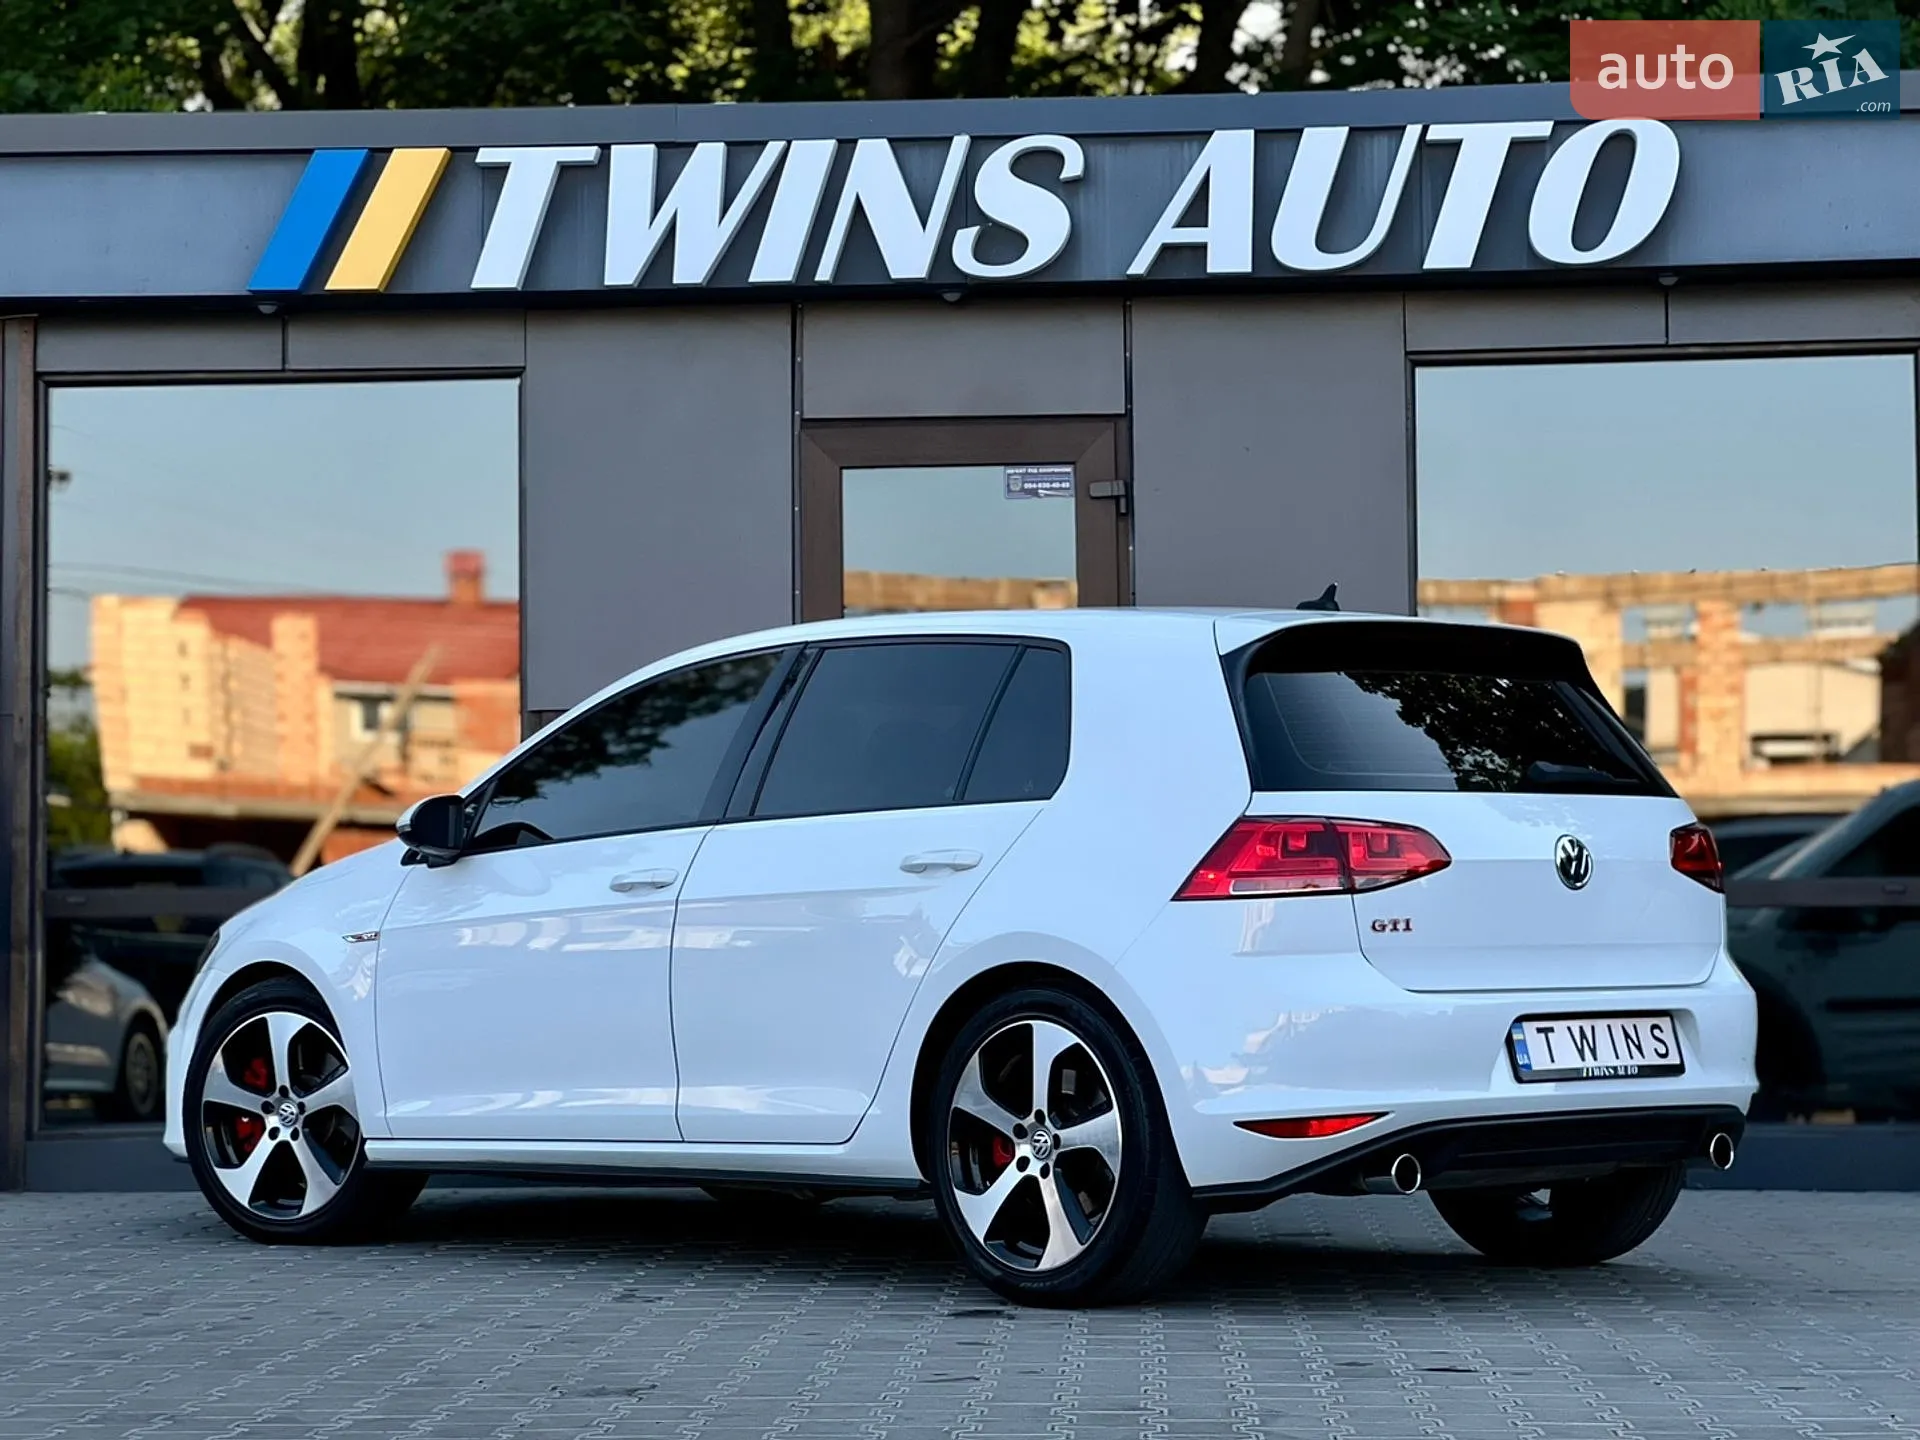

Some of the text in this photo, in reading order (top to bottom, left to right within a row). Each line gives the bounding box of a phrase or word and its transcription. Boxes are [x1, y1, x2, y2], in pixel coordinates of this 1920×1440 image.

[470, 116, 1681, 289] TWINS AUTO
[1371, 917, 1413, 932] GTI
